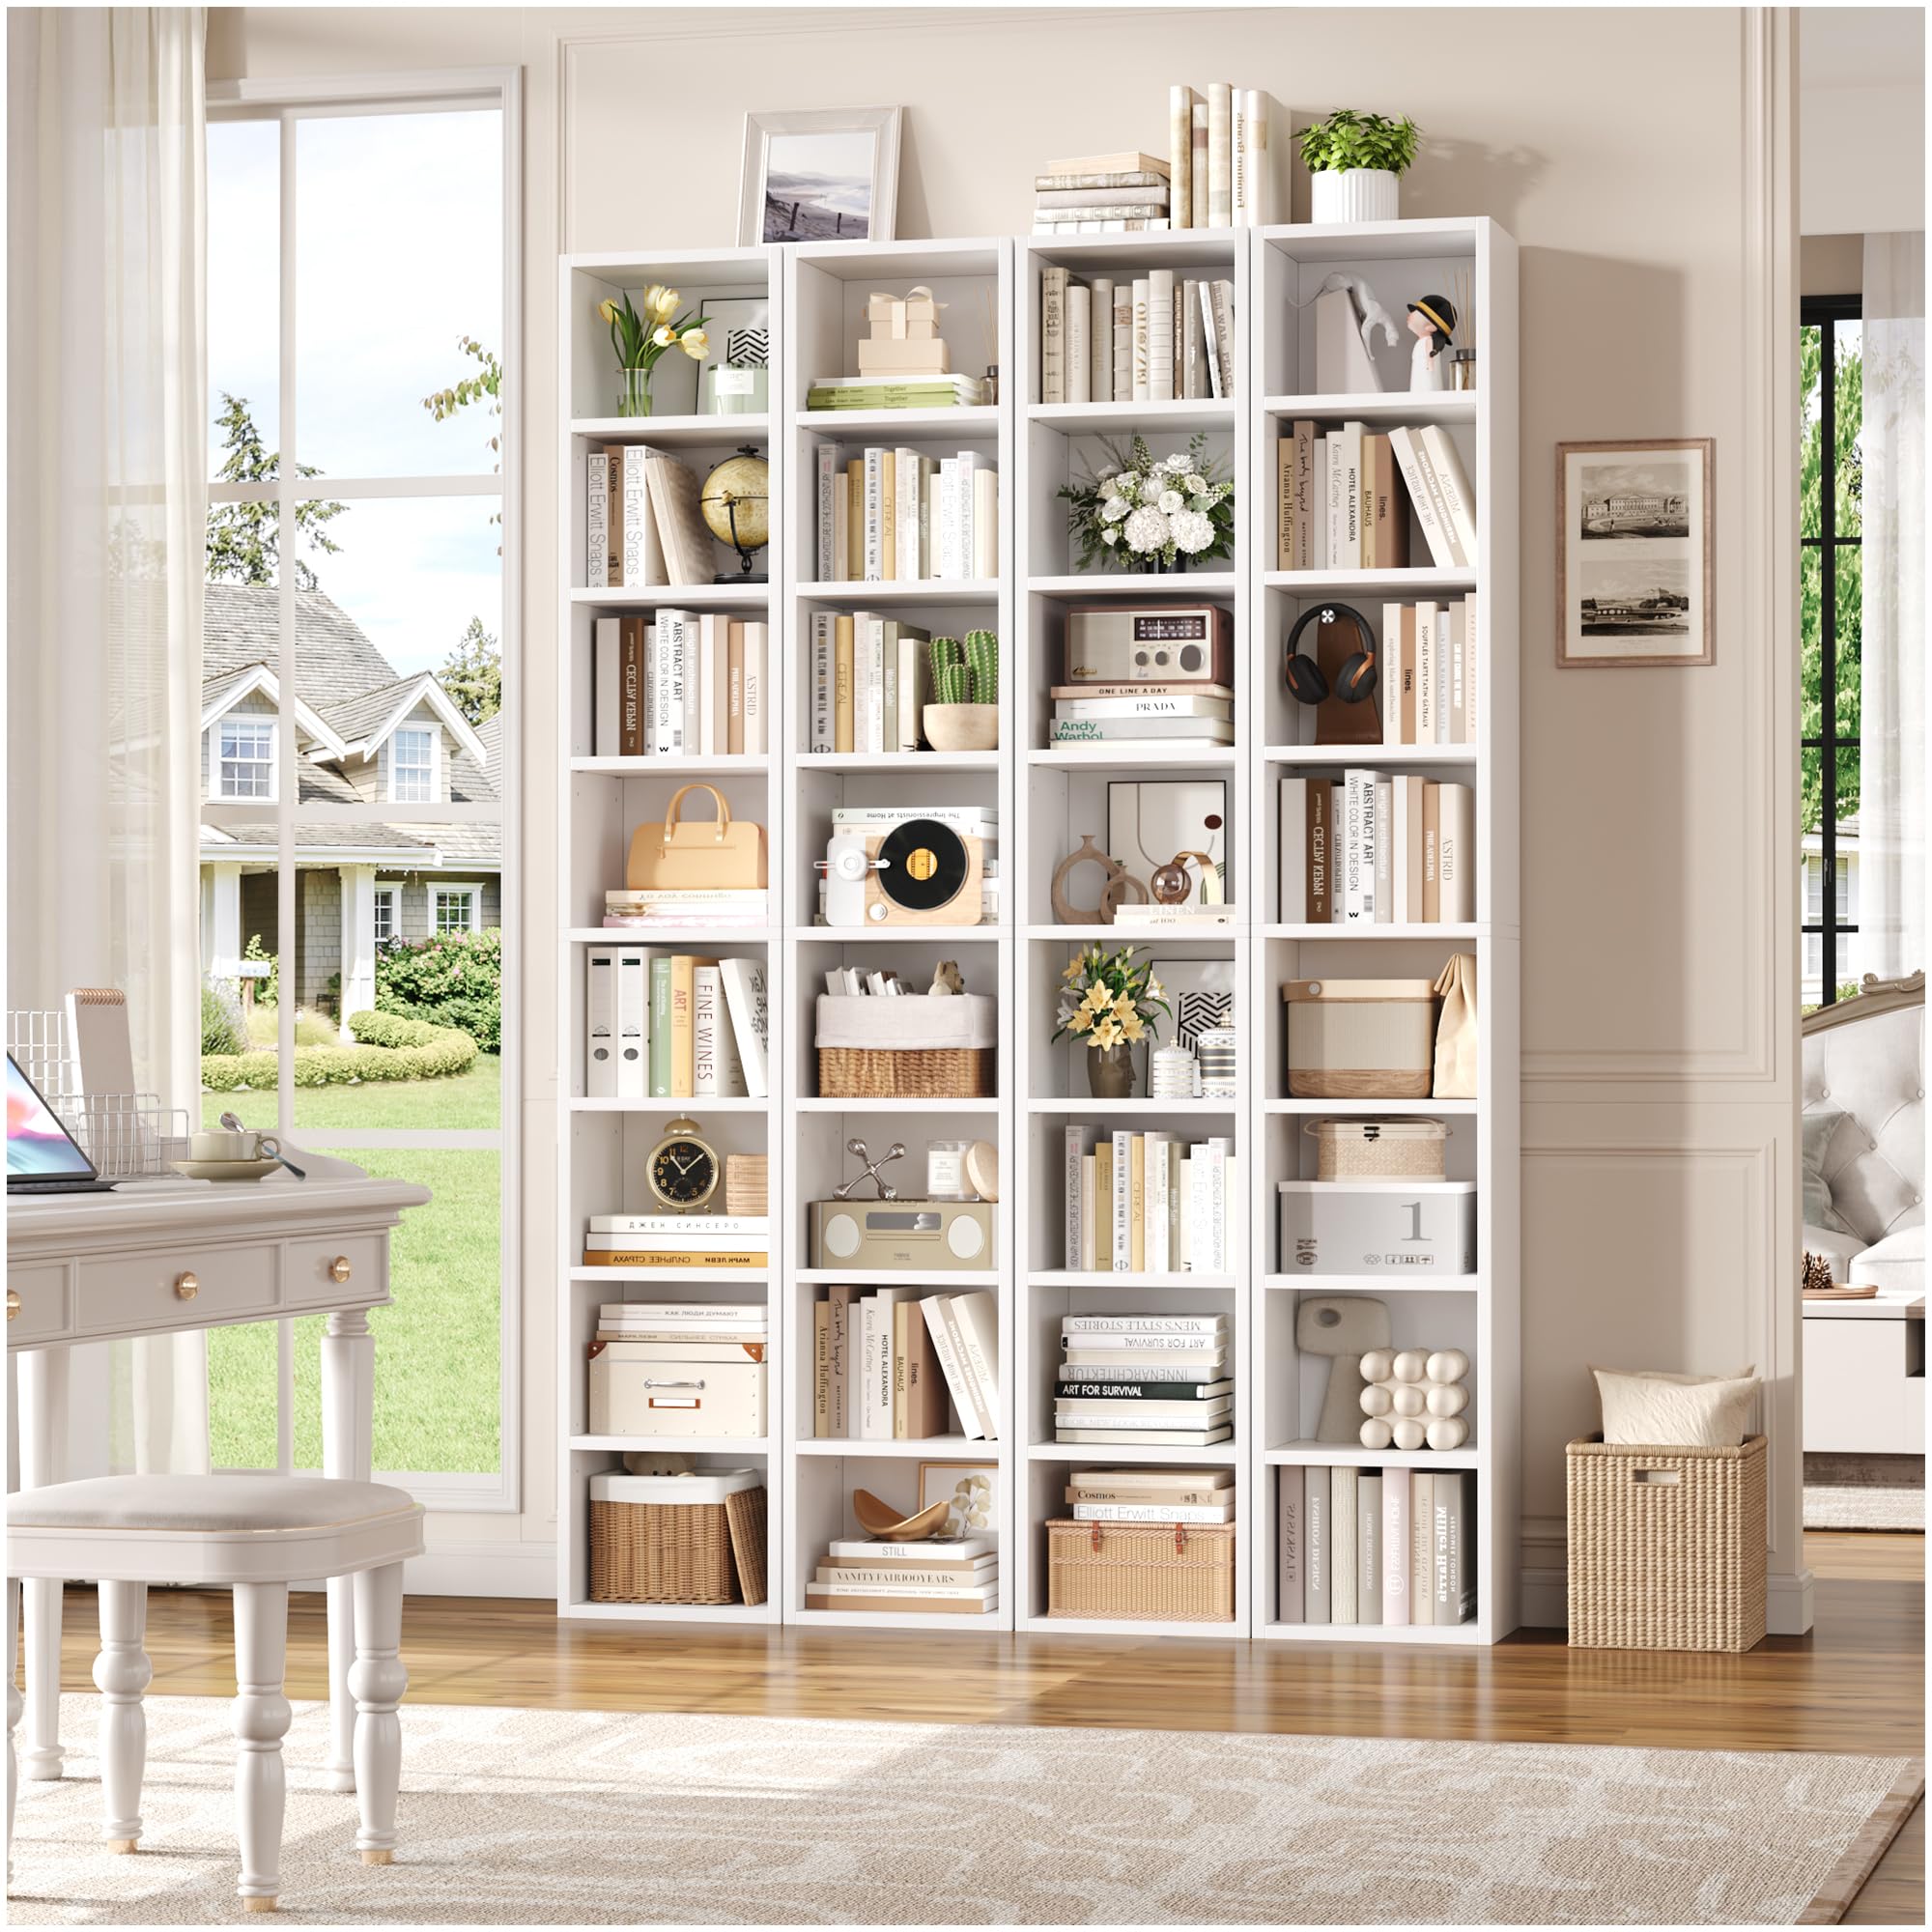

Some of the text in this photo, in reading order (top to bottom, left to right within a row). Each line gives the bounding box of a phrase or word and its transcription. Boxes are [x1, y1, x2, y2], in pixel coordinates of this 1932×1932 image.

[1216, 313, 1228, 342] WAR
[1222, 351, 1234, 390] PEACE
[610, 456, 621, 493] Cosmos
[588, 457, 606, 576] Elliott Erwitt Snaps
[625, 449, 642, 575] Elliott Erwitt Snaps
[1281, 463, 1293, 554] Arianna Huffington
[1378, 496, 1387, 521] lines.
[660, 615, 668, 644] WHITE
[660, 646, 668, 675] COLOR
[672, 621, 683, 702] ABSTRACT ART
[660, 689, 668, 726] DESIGN
[747, 674, 757, 716] ASTRID
[1136, 703, 1176, 712] PRADA
[1061, 721, 1097, 733] Andy
[896, 811, 946, 820] Impressionists
[1363, 782, 1374, 866] ABSTRACT ART
[1349, 777, 1358, 892] WHITE COLOR IN DESIGN
[1443, 838, 1454, 881] ASTRID
[673, 989, 687, 1011] ART
[697, 984, 713, 1080] FINE WINES
[660, 1156, 669, 1165] 10
[660, 1179, 668, 1187] 8
[669, 1187, 675, 1196] 7
[1401, 1202, 1433, 1241] 1
[1074, 1321, 1122, 1330] STORIES
[1126, 1321, 1162, 1330] STYLE
[1124, 1338, 1206, 1348] ART FOR SURVIVAL
[817, 1325, 829, 1414] Arianna Huffington
[1068, 1368, 1188, 1381] INNENARCHITEKTUR
[1063, 1385, 1143, 1397] ART FOR SURVIVAL
[1077, 1490, 1116, 1500] Cosmos
[1077, 1505, 1205, 1522] Elliott Erwitt Snaps
[882, 1546, 907, 1556] STILL
